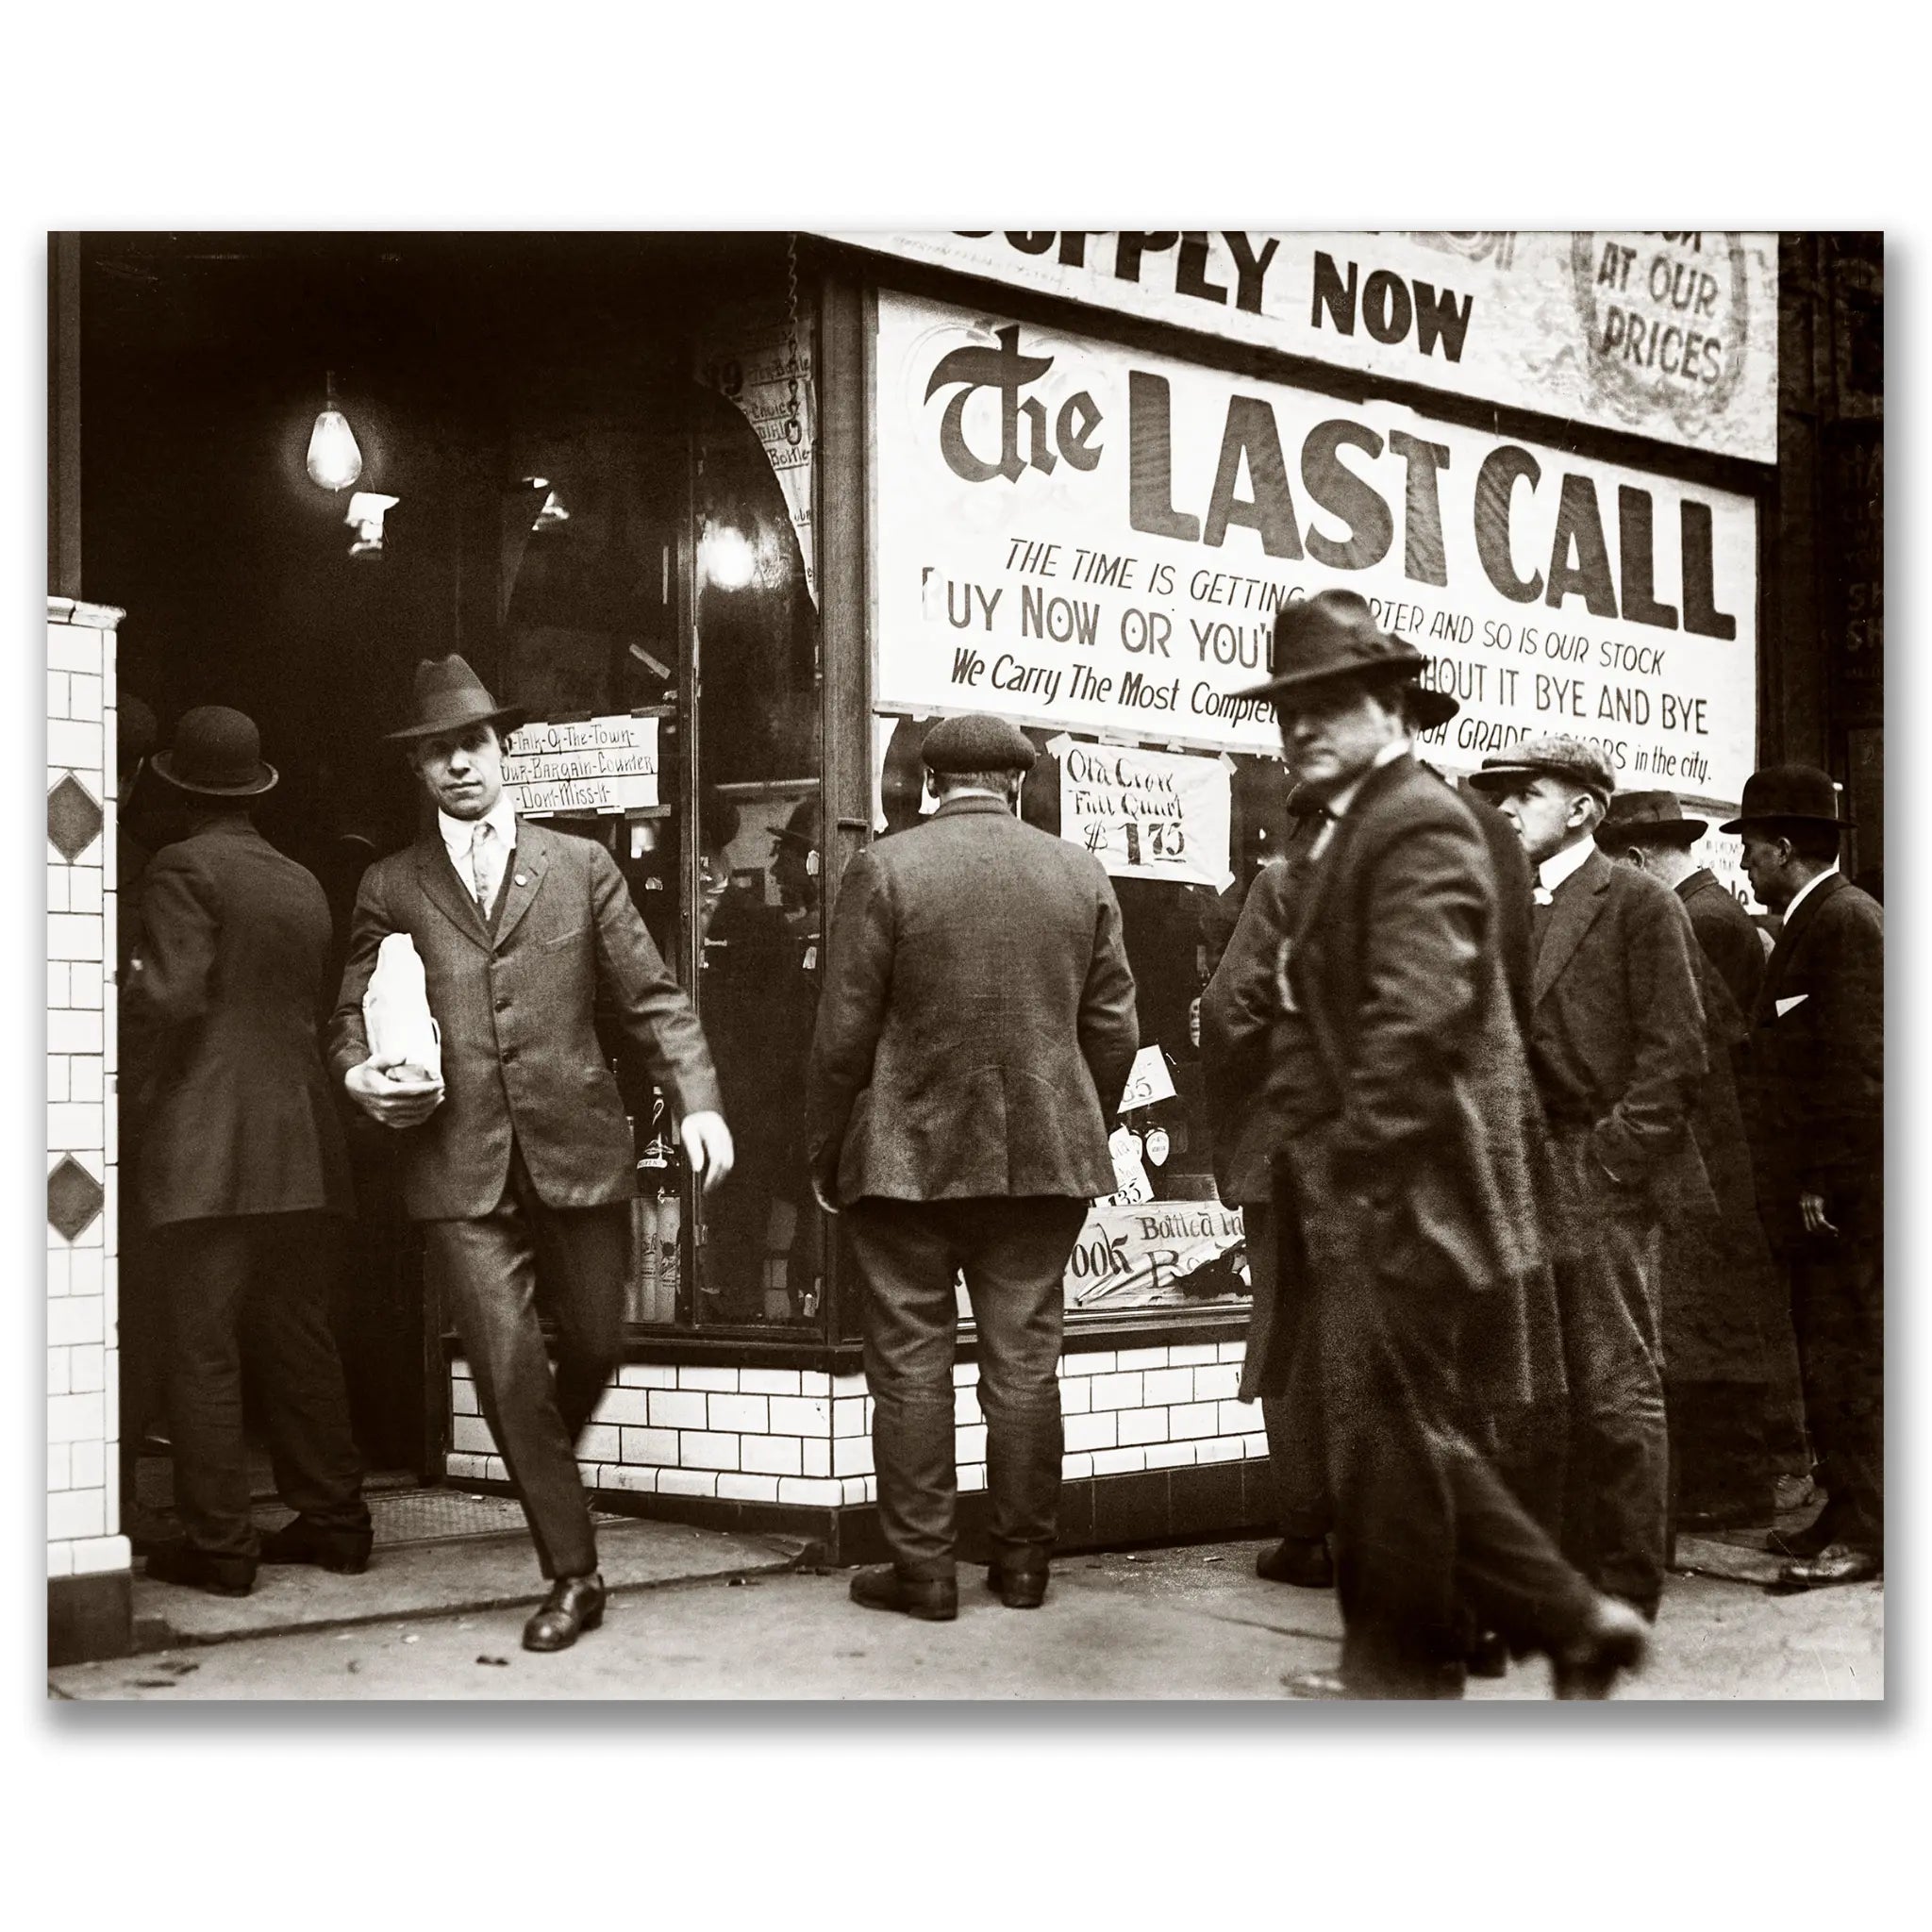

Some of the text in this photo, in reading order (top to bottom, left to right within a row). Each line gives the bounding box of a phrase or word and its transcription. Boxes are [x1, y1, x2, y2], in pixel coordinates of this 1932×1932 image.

[1311, 251, 1474, 363] NOW
[1598, 242, 1719, 318] AT OUR
[1602, 305, 1722, 385] PRICES
[924, 325, 1737, 641] The LAST CALL
[1006, 538, 1063, 576] THE
[1073, 549, 1139, 590] TIME
[1148, 563, 1177, 595] IS
[1429, 610, 1474, 643] AND
[1483, 620, 1512, 649] SO
[1519, 626, 1538, 655] IS
[1545, 632, 1590, 663] OUR
[1599, 641, 1667, 676] STOCK
[1022, 584, 1101, 647] NOW
[1121, 607, 1171, 658] OR
[1500, 667, 1520, 707] IT
[1536, 674, 1587, 718] BYE
[1598, 684, 1650, 725] AND
[1661, 693, 1709, 735] BYE
[951, 647, 985, 687] We
[991, 654, 1063, 707] Carry
[1069, 663, 1112, 704] The
[1119, 671, 1179, 712] Most
[1634, 744, 1648, 774] in
[1653, 746, 1676, 776] the
[1680, 752, 1713, 785] city.
[1067, 748, 1174, 792] Old Crow
[1067, 790, 1184, 821] Full Quart
[1135, 1211, 1216, 1241] Bottled
